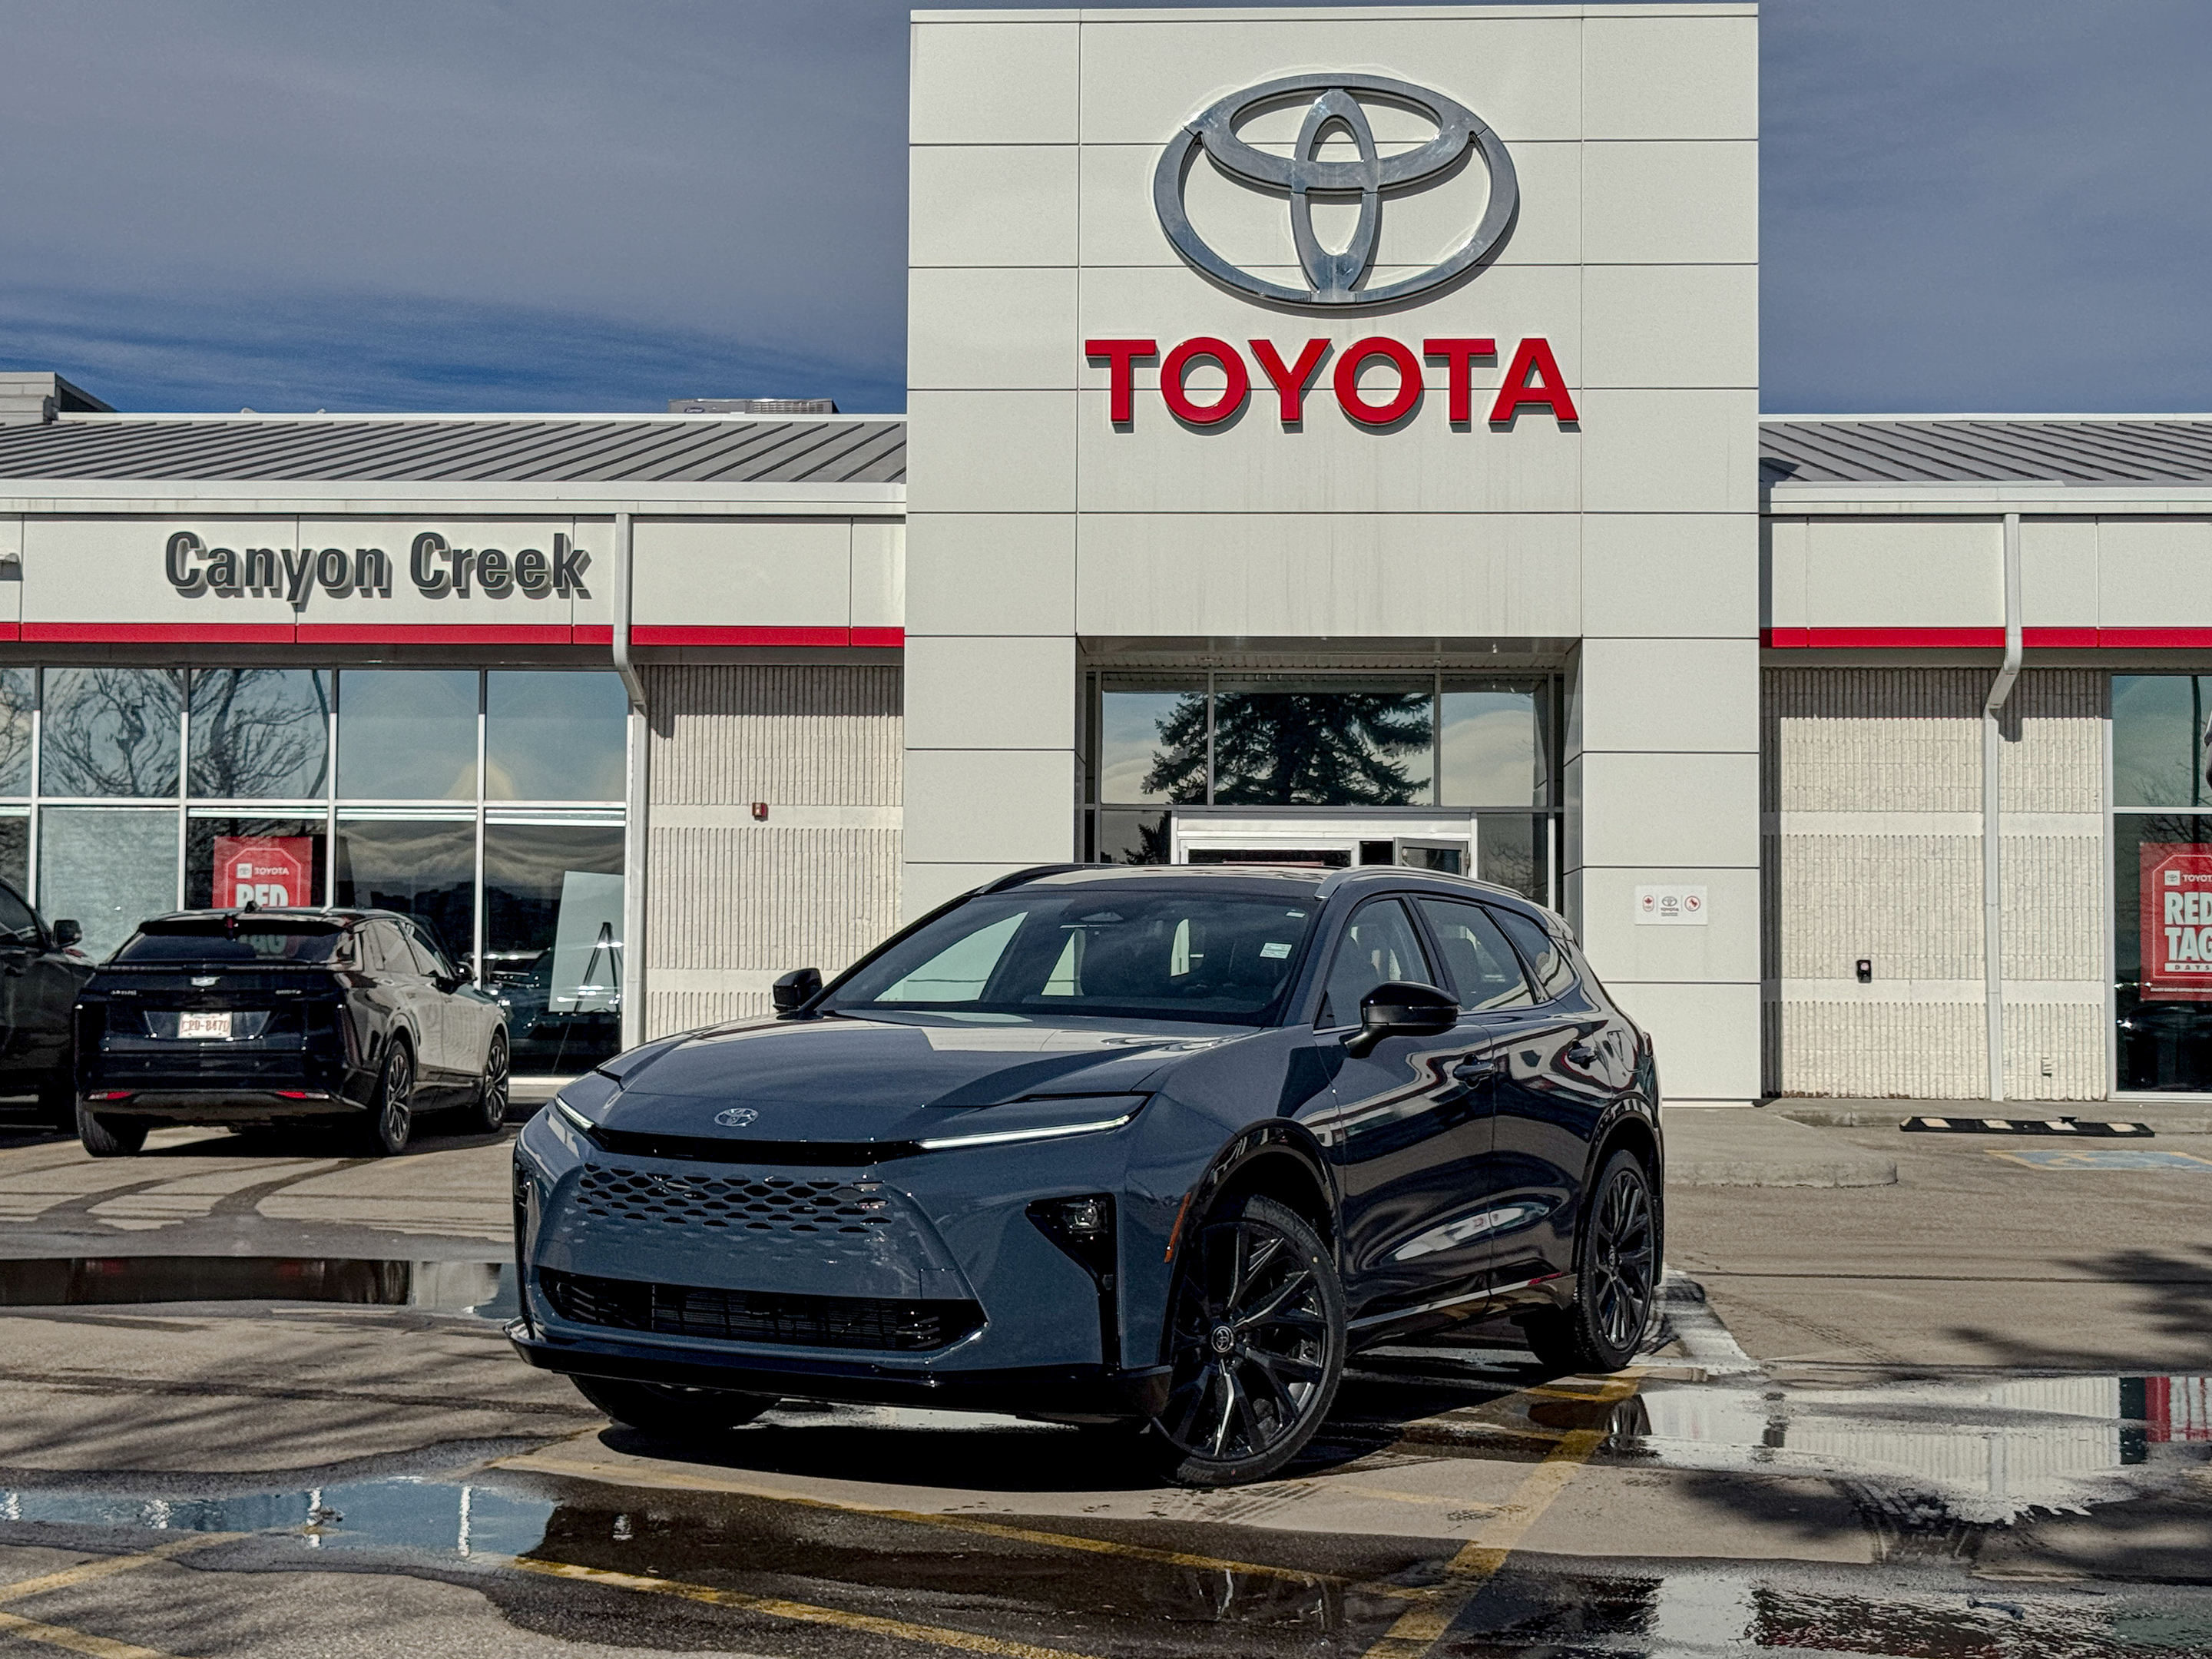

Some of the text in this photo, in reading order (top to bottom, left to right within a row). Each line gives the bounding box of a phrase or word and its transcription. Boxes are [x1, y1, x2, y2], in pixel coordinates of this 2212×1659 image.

[1084, 336, 1579, 425] TOYOTA
[165, 531, 588, 604] Canyon Creek
[254, 867, 290, 876] TOYOTA
[2182, 874, 2212, 882] TOYOT
[2164, 891, 2212, 926] RED
[2164, 927, 2212, 962] TAG
